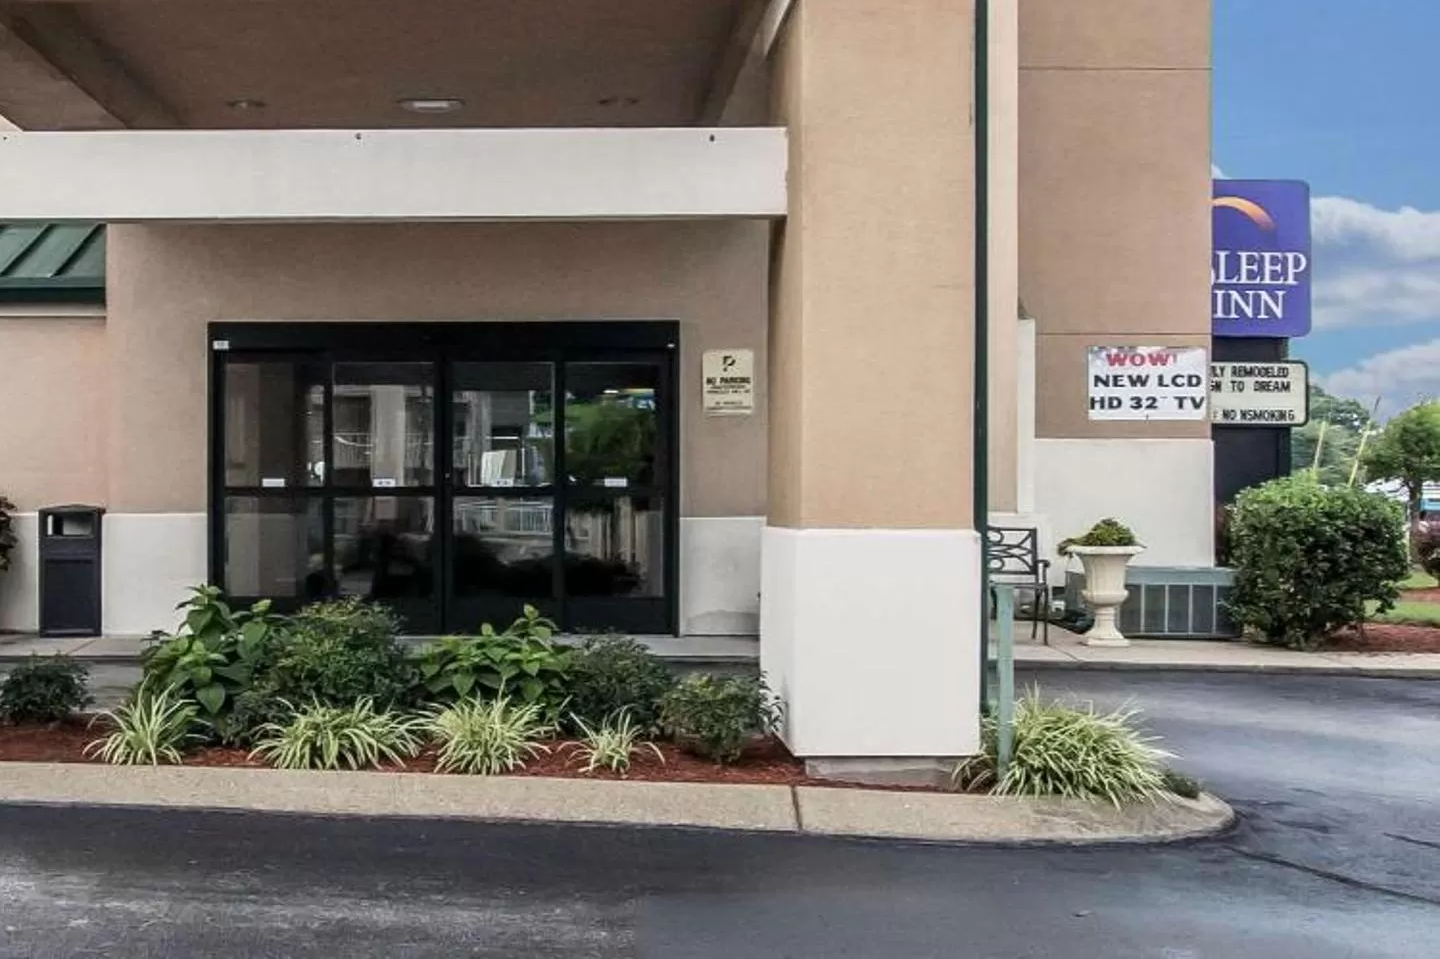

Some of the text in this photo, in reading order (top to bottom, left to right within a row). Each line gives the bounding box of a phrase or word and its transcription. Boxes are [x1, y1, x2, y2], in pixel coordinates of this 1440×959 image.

[1211, 250, 1307, 285] LEEP
[1213, 290, 1287, 318] INN
[1094, 375, 1202, 388] NEW LCD
[1231, 380, 1245, 392] TO
[1253, 380, 1291, 393] DREAM
[1090, 396, 1123, 410] HD
[1173, 396, 1205, 410] TV
